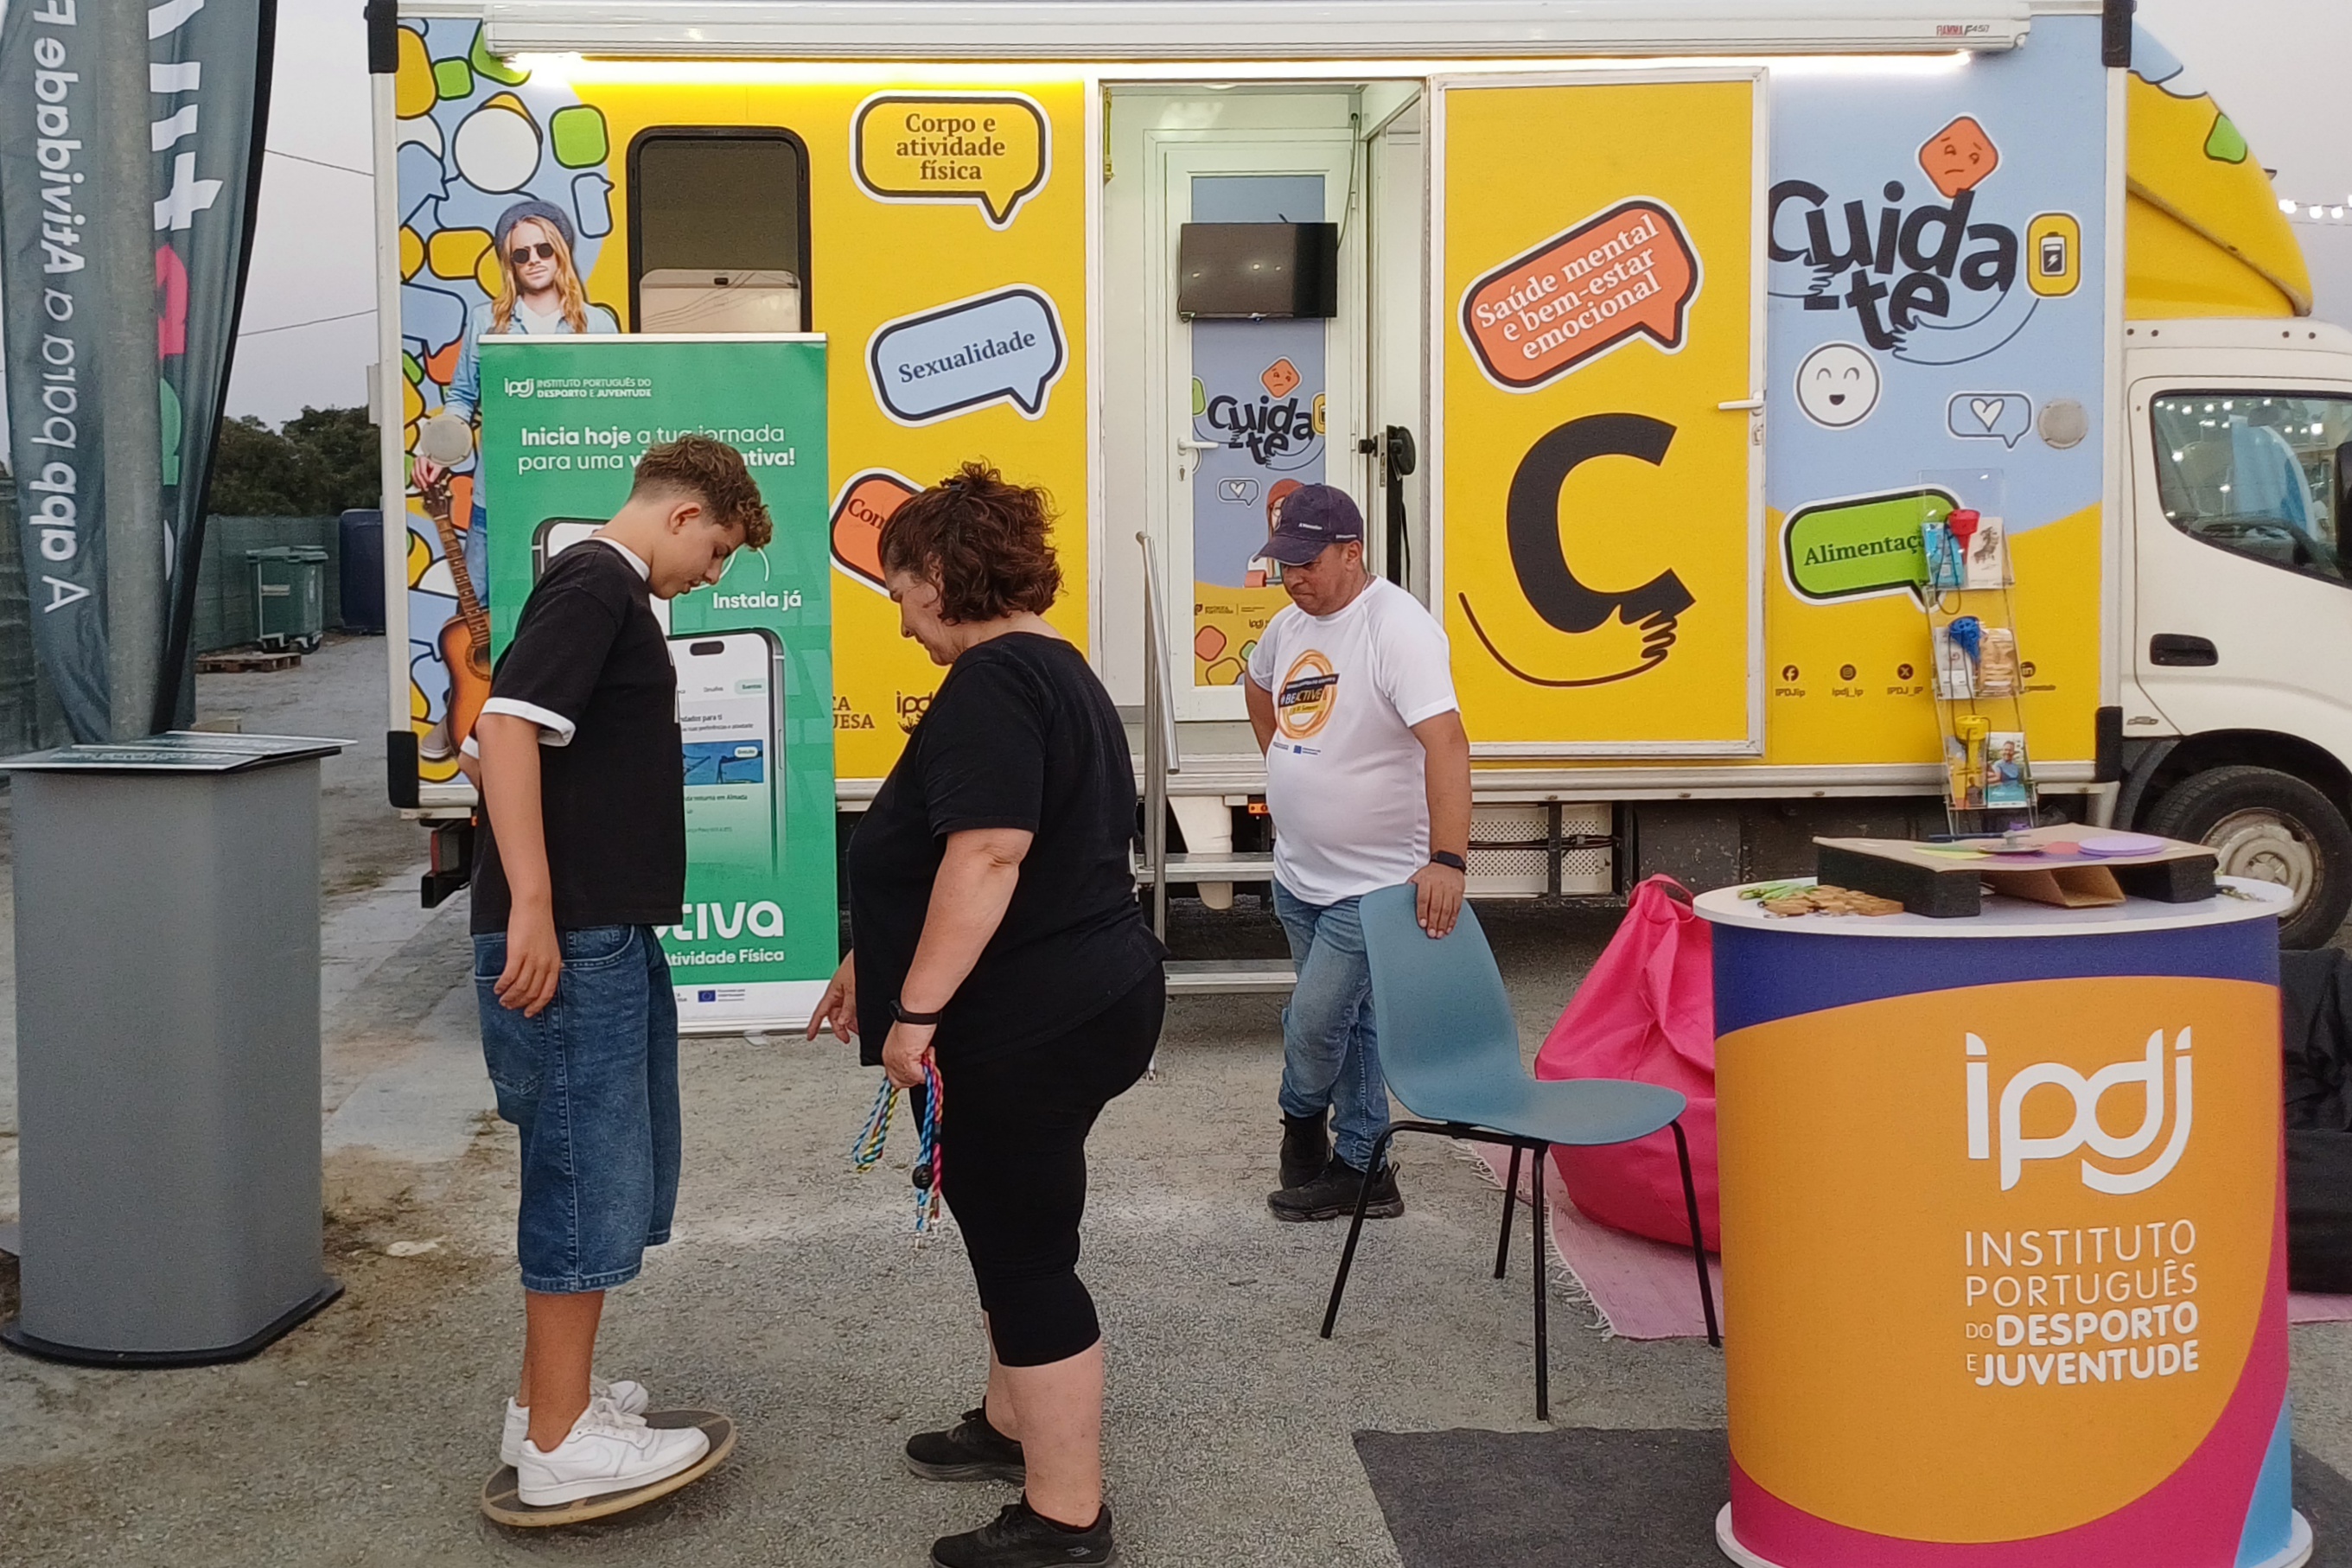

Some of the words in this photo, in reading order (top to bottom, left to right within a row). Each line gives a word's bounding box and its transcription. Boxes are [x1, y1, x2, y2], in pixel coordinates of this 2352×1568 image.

[896, 137, 1006, 156] atividade
[905, 113, 977, 137] Corpo
[983, 118, 997, 132] e
[919, 159, 983, 181] física
[1768, 180, 2018, 292] Cuida
[1476, 273, 1559, 328] Saúde
[1561, 214, 1660, 283] mental
[1503, 322, 1521, 341] e
[1520, 248, 1656, 332] bem-estar
[1521, 270, 1662, 360] emocional
[898, 330, 1036, 383] Sexualidade
[537, 379, 581, 388] INSTITUTO
[583, 377, 635, 387] PORTUGUÊS
[638, 379, 652, 387] DO
[537, 389, 588, 398] DESPORTO
[596, 389, 652, 398] JUVENTUDE
[521, 426, 580, 446] Inicia
[584, 425, 632, 449] hoje
[636, 430, 651, 444] a
[1208, 395, 1315, 441] Cuida
[519, 456, 571, 475] para
[577, 455, 623, 469] uma
[1803, 535, 1926, 566] Alimentaç
[712, 591, 779, 609] Instala
[781, 590, 802, 612] já
[739, 947, 785, 964] Física
[1965, 1024, 2194, 1195] ipdj
[1965, 1219, 2196, 1268] INSTITUTO
[1966, 1259, 2198, 1308] PORTUGUÊS
[1965, 1323, 1993, 1340] DO
[1996, 1300, 2199, 1348] DESPORTO
[1966, 1354, 1978, 1373] E
[1975, 1340, 2200, 1387] JUVENTUDE
